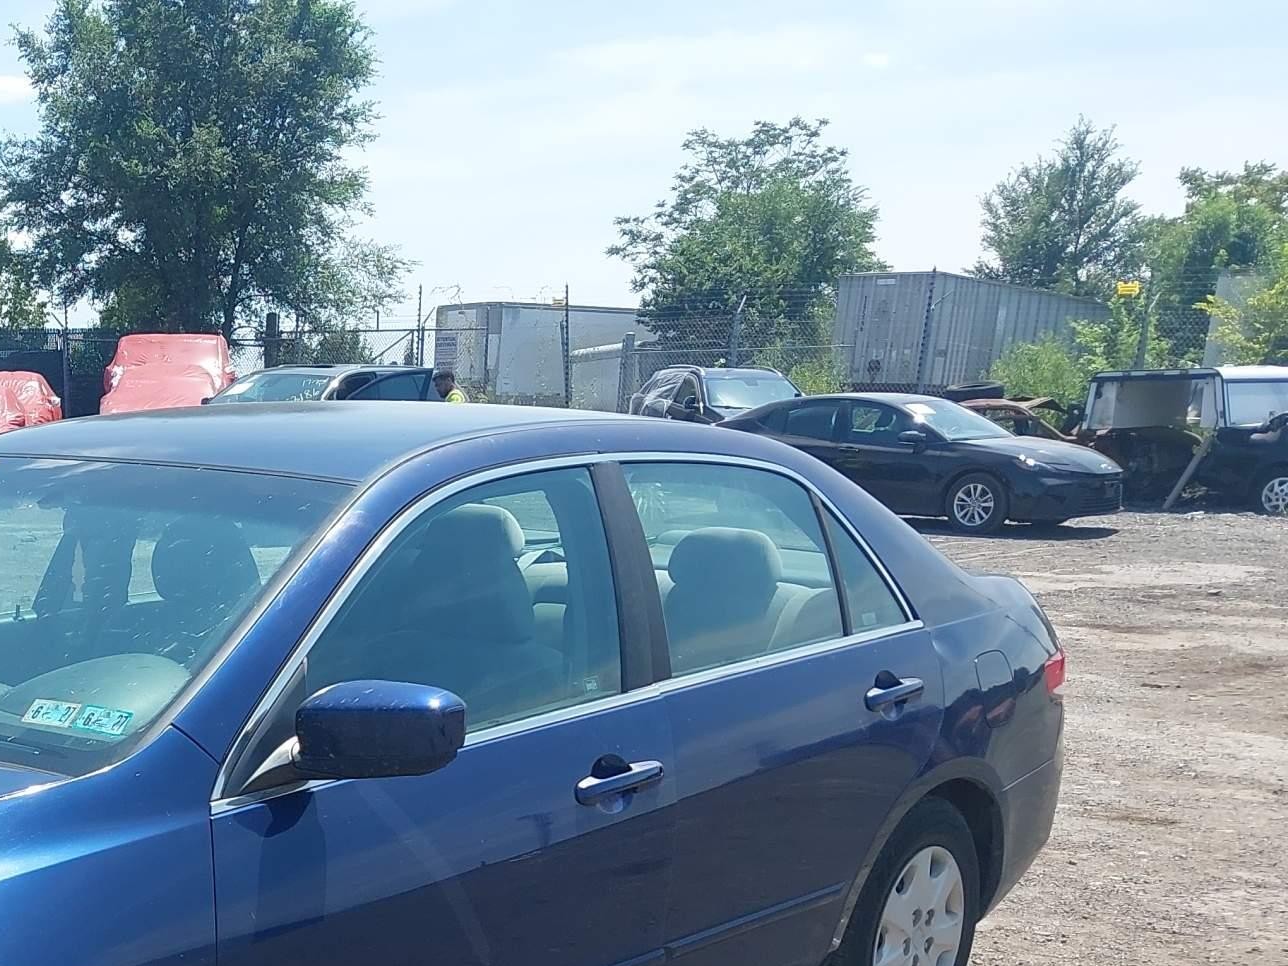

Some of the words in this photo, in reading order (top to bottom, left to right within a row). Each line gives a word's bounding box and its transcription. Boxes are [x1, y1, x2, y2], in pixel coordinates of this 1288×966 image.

[32, 705, 43, 719] 6
[58, 706, 77, 724] 27
[83, 712, 95, 727] 6
[111, 714, 129, 731] 27
